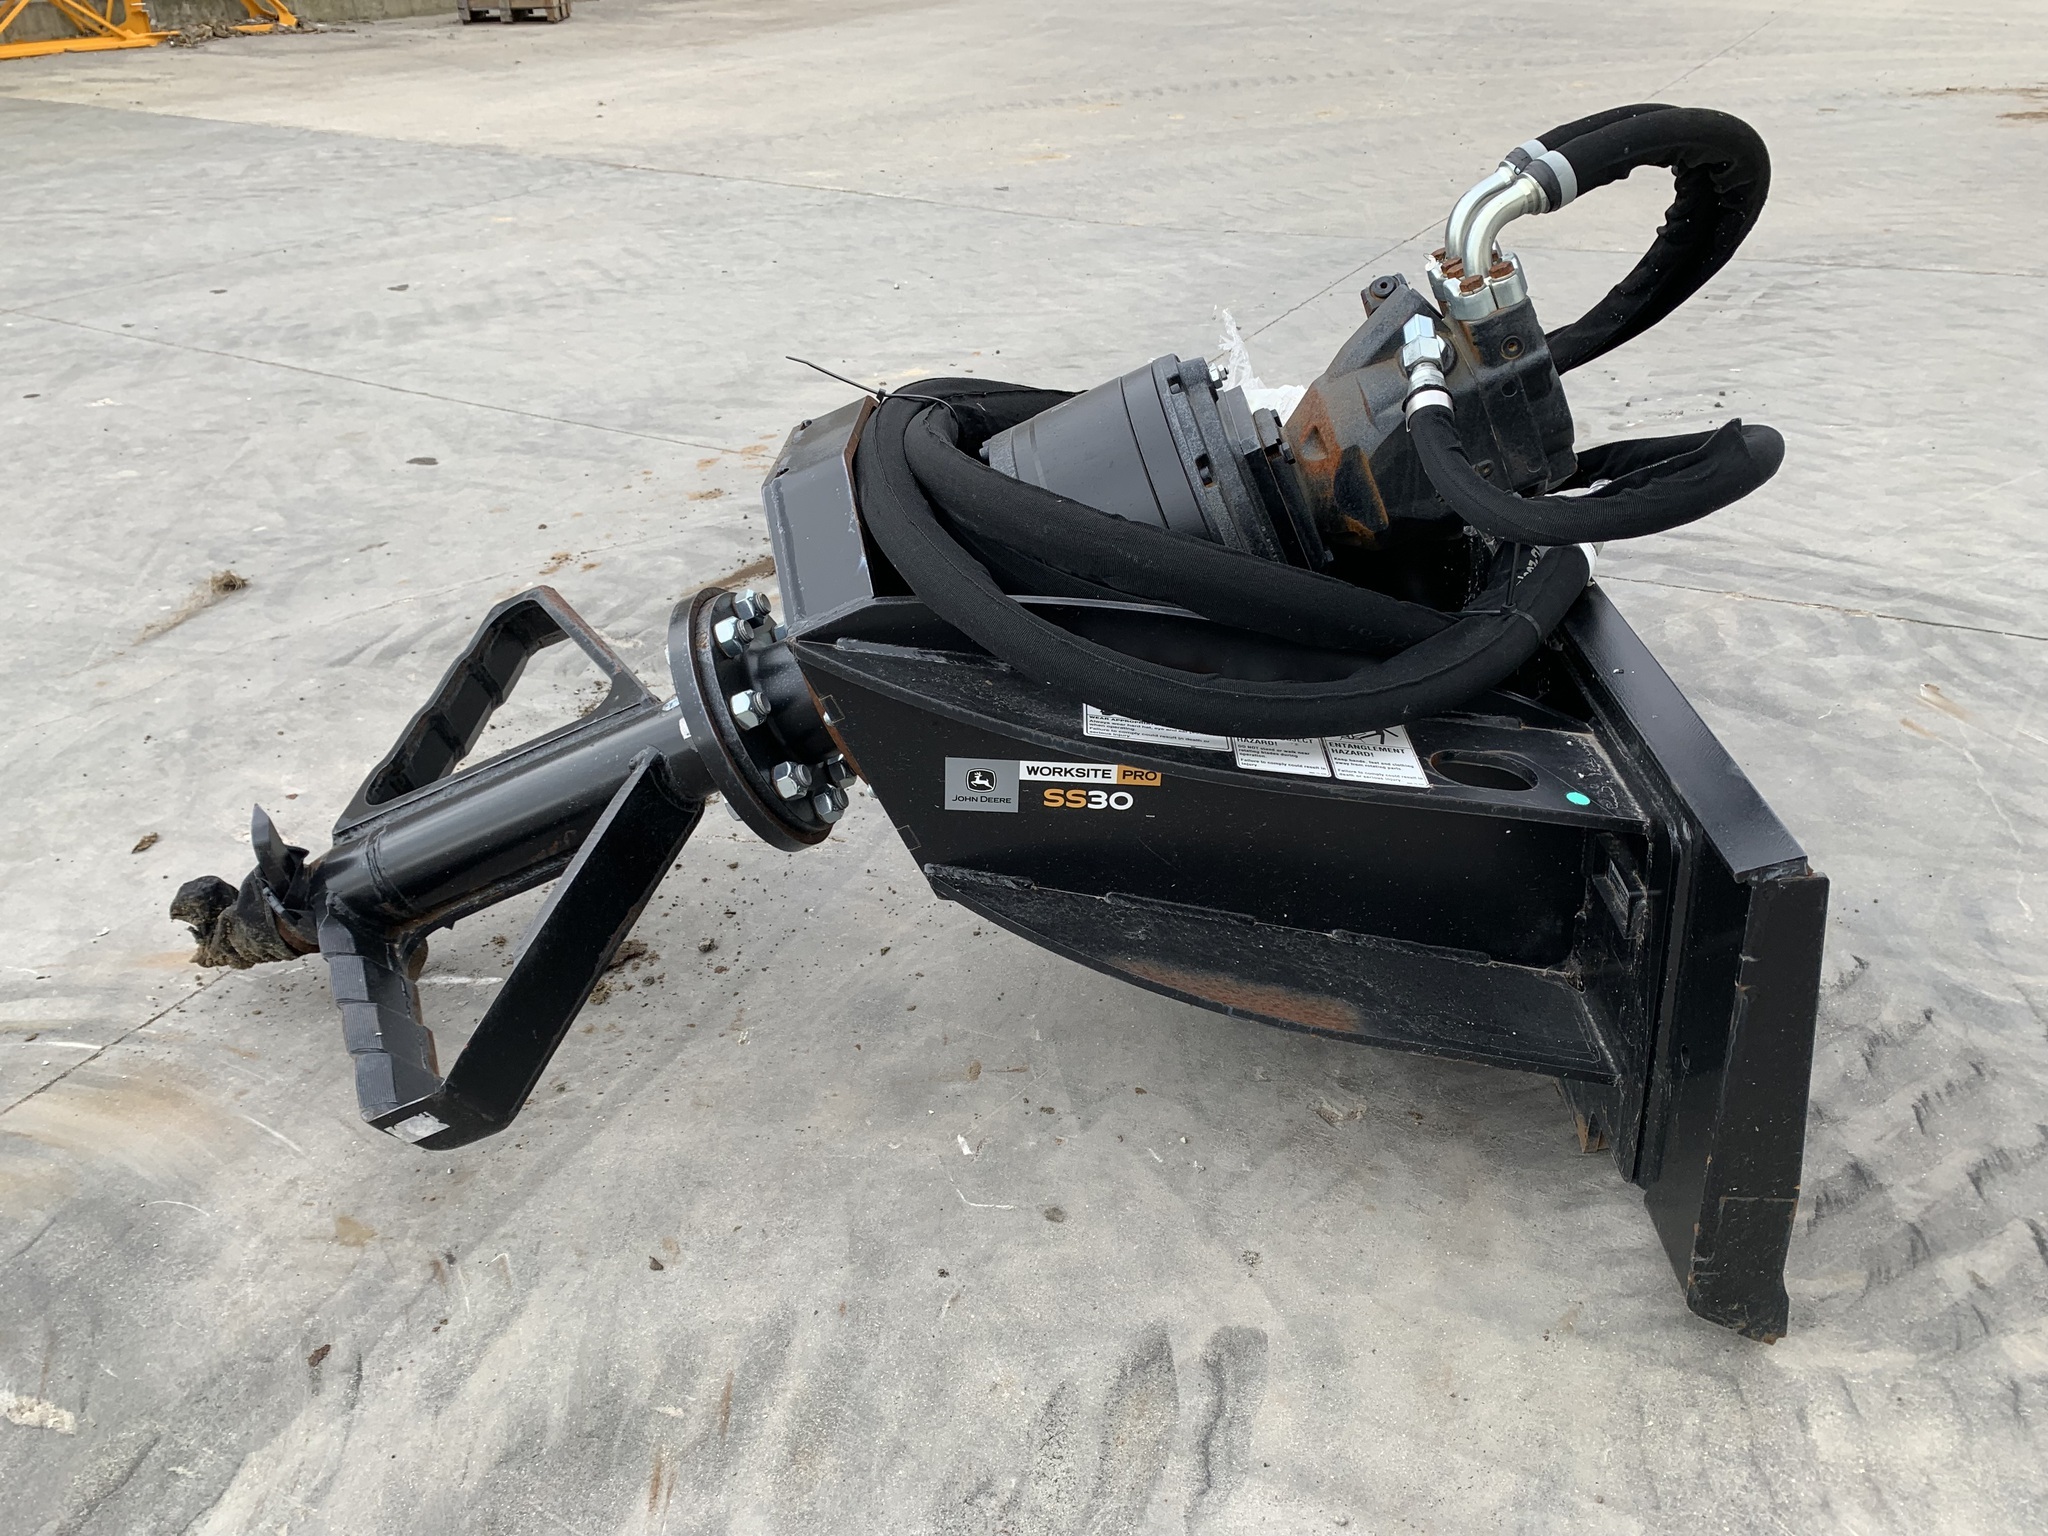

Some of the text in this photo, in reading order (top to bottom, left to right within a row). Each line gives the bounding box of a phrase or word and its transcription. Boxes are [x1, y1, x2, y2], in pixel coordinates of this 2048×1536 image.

[1238, 738, 1278, 746] HAZARD!
[1329, 742, 1404, 754] ENTANGLEMENT
[1331, 748, 1374, 758] HAZARD!
[1026, 766, 1158, 782] WORKSITE PRO
[952, 794, 1012, 804] JOHN DEERE
[1043, 788, 1134, 811] SS30
